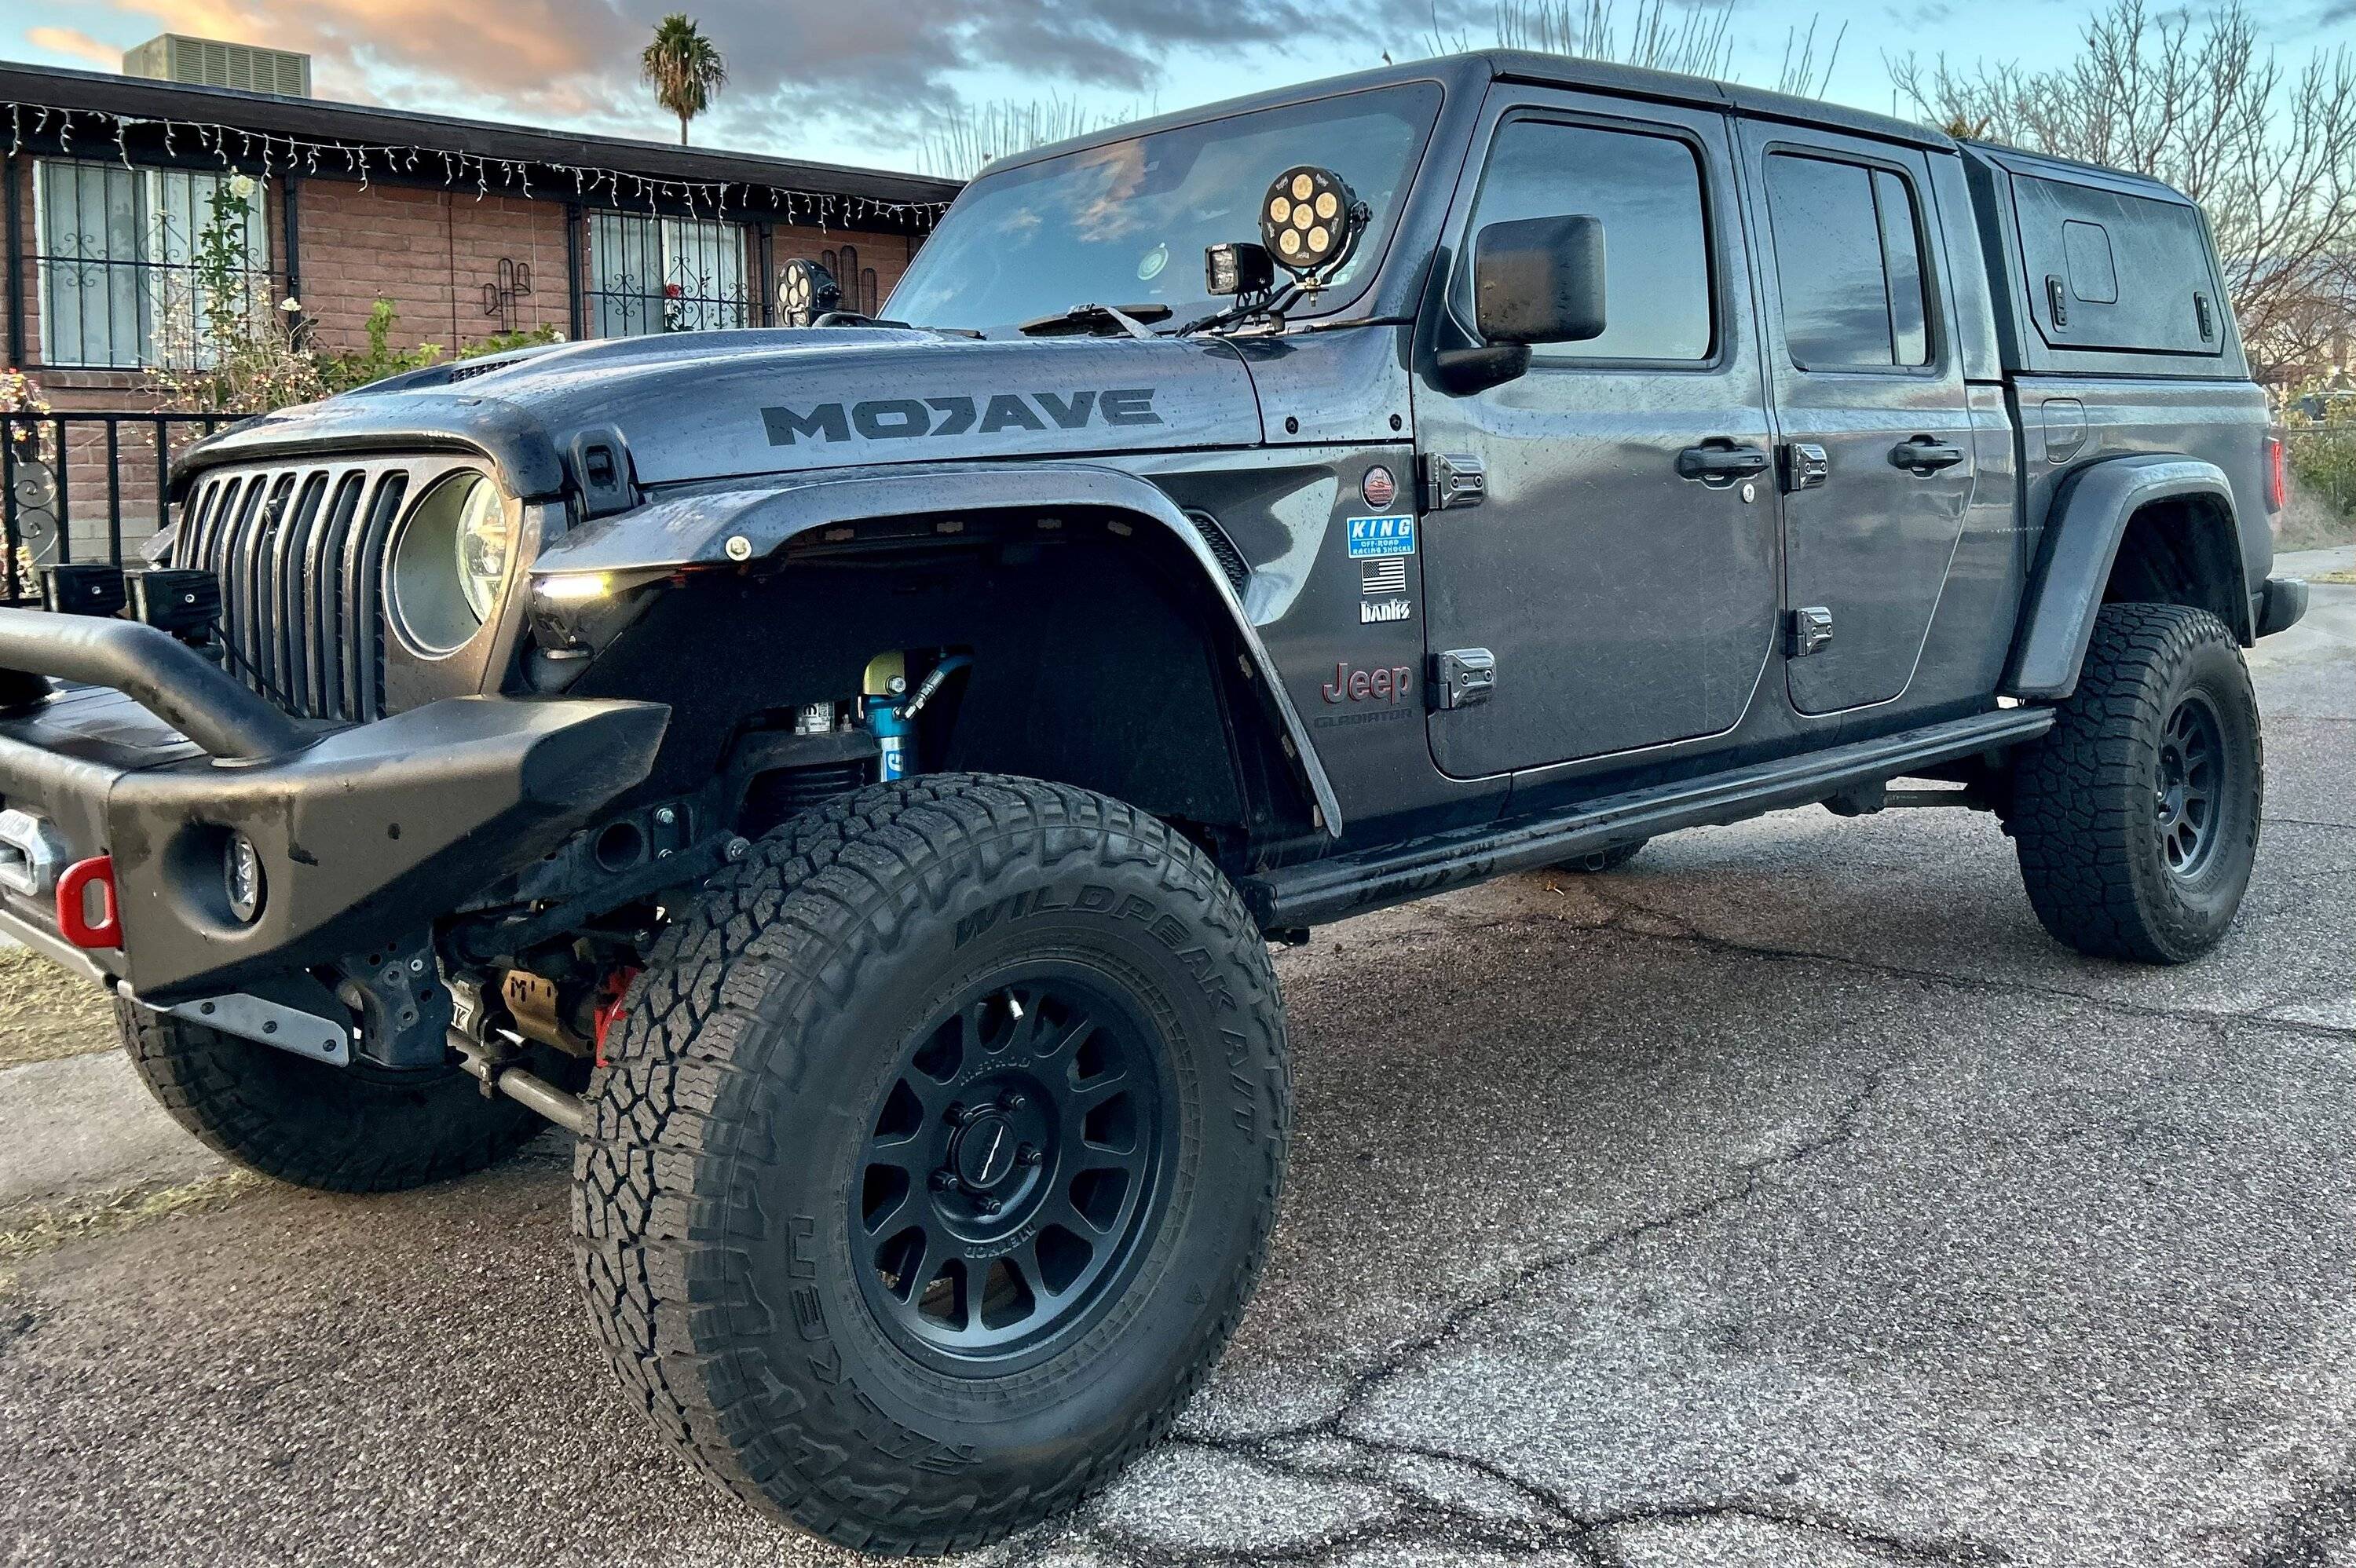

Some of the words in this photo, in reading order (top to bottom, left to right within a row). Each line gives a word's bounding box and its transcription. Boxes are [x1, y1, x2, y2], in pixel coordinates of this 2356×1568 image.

[759, 388, 1165, 447] MOJAVE
[1352, 518, 1411, 539] KING
[1383, 545, 1411, 554] SHOCKS
[1322, 663, 1413, 705] Jeep
[953, 884, 1238, 1014] WILDPEAK
[1220, 1027, 1257, 1145] A/T
[787, 1214, 983, 1477] FALKEN
